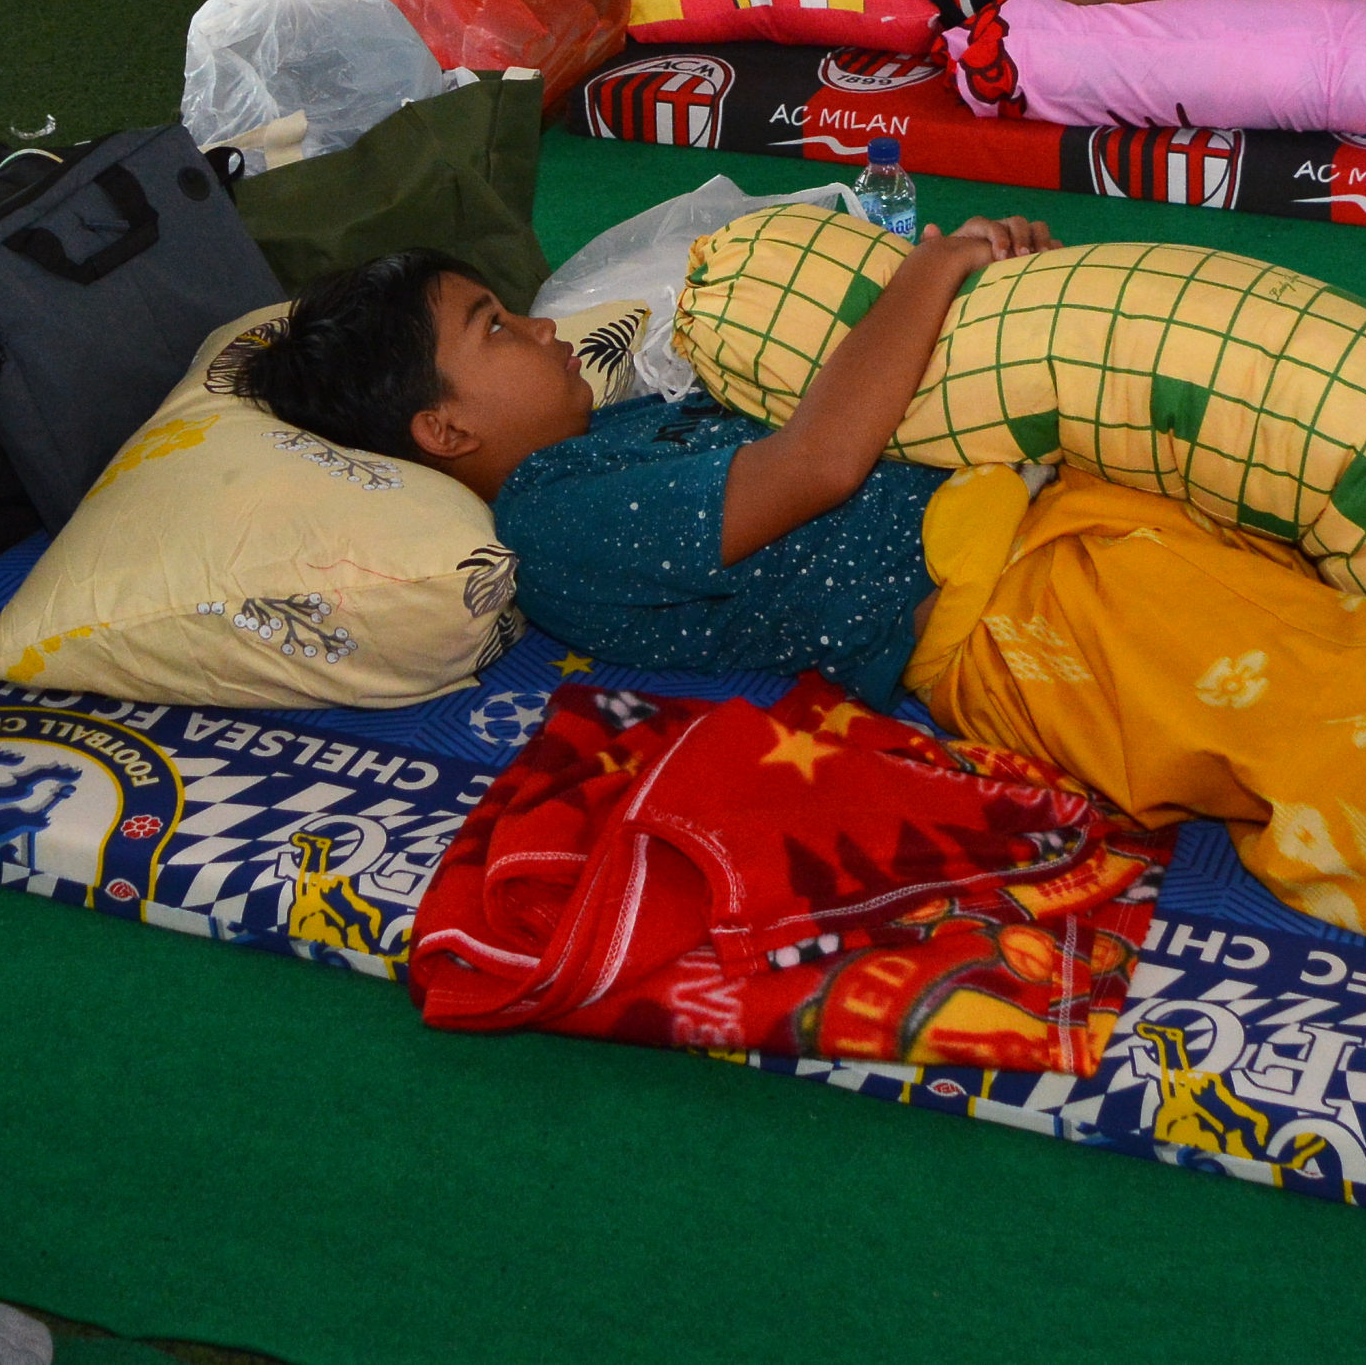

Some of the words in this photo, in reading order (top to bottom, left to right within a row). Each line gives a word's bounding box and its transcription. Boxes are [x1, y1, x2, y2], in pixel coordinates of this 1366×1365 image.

[653, 55, 718, 82] ACM
[768, 102, 809, 128] AC
[812, 106, 910, 137] MILAN
[1292, 158, 1339, 183] AC
[36, 717, 161, 789] FOOTBALL
[186, 709, 440, 793] CHELSEA
